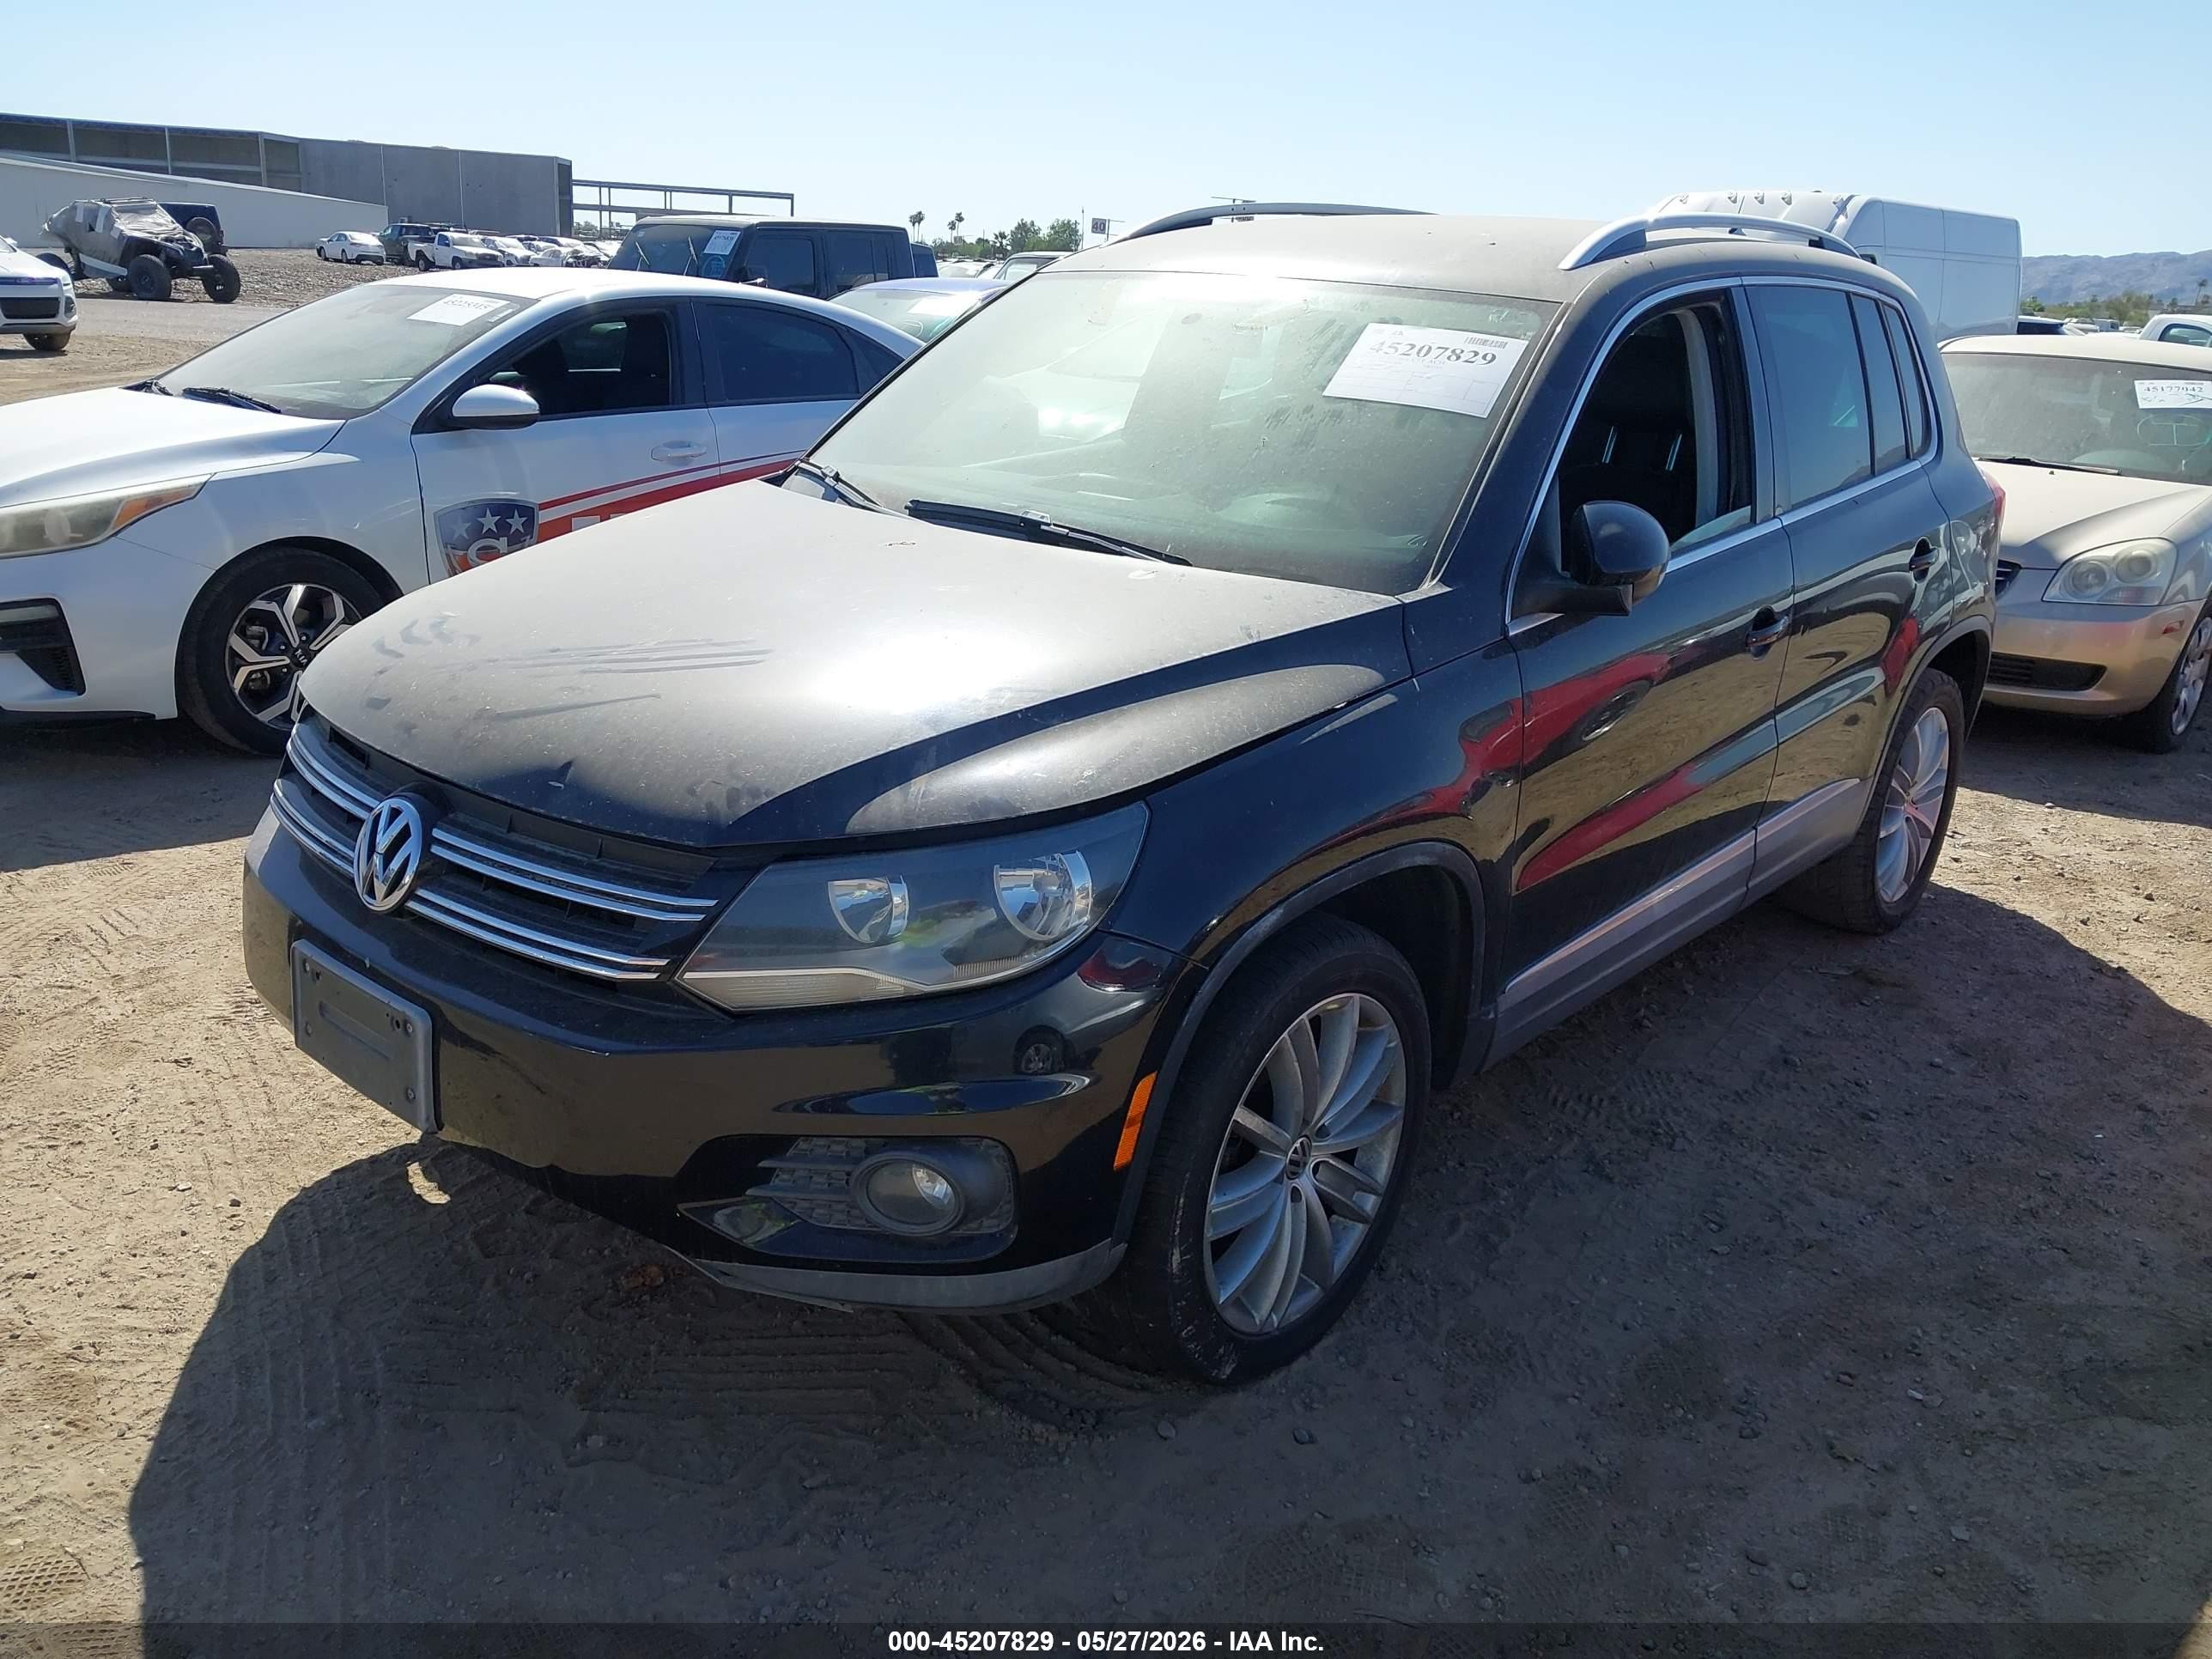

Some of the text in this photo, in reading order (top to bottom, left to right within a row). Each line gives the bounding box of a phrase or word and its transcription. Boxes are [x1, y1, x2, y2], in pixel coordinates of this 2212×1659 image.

[1092, 222, 1106, 231] 40
[1370, 340, 1497, 366] 45207829
[353, 797, 422, 911] VW
